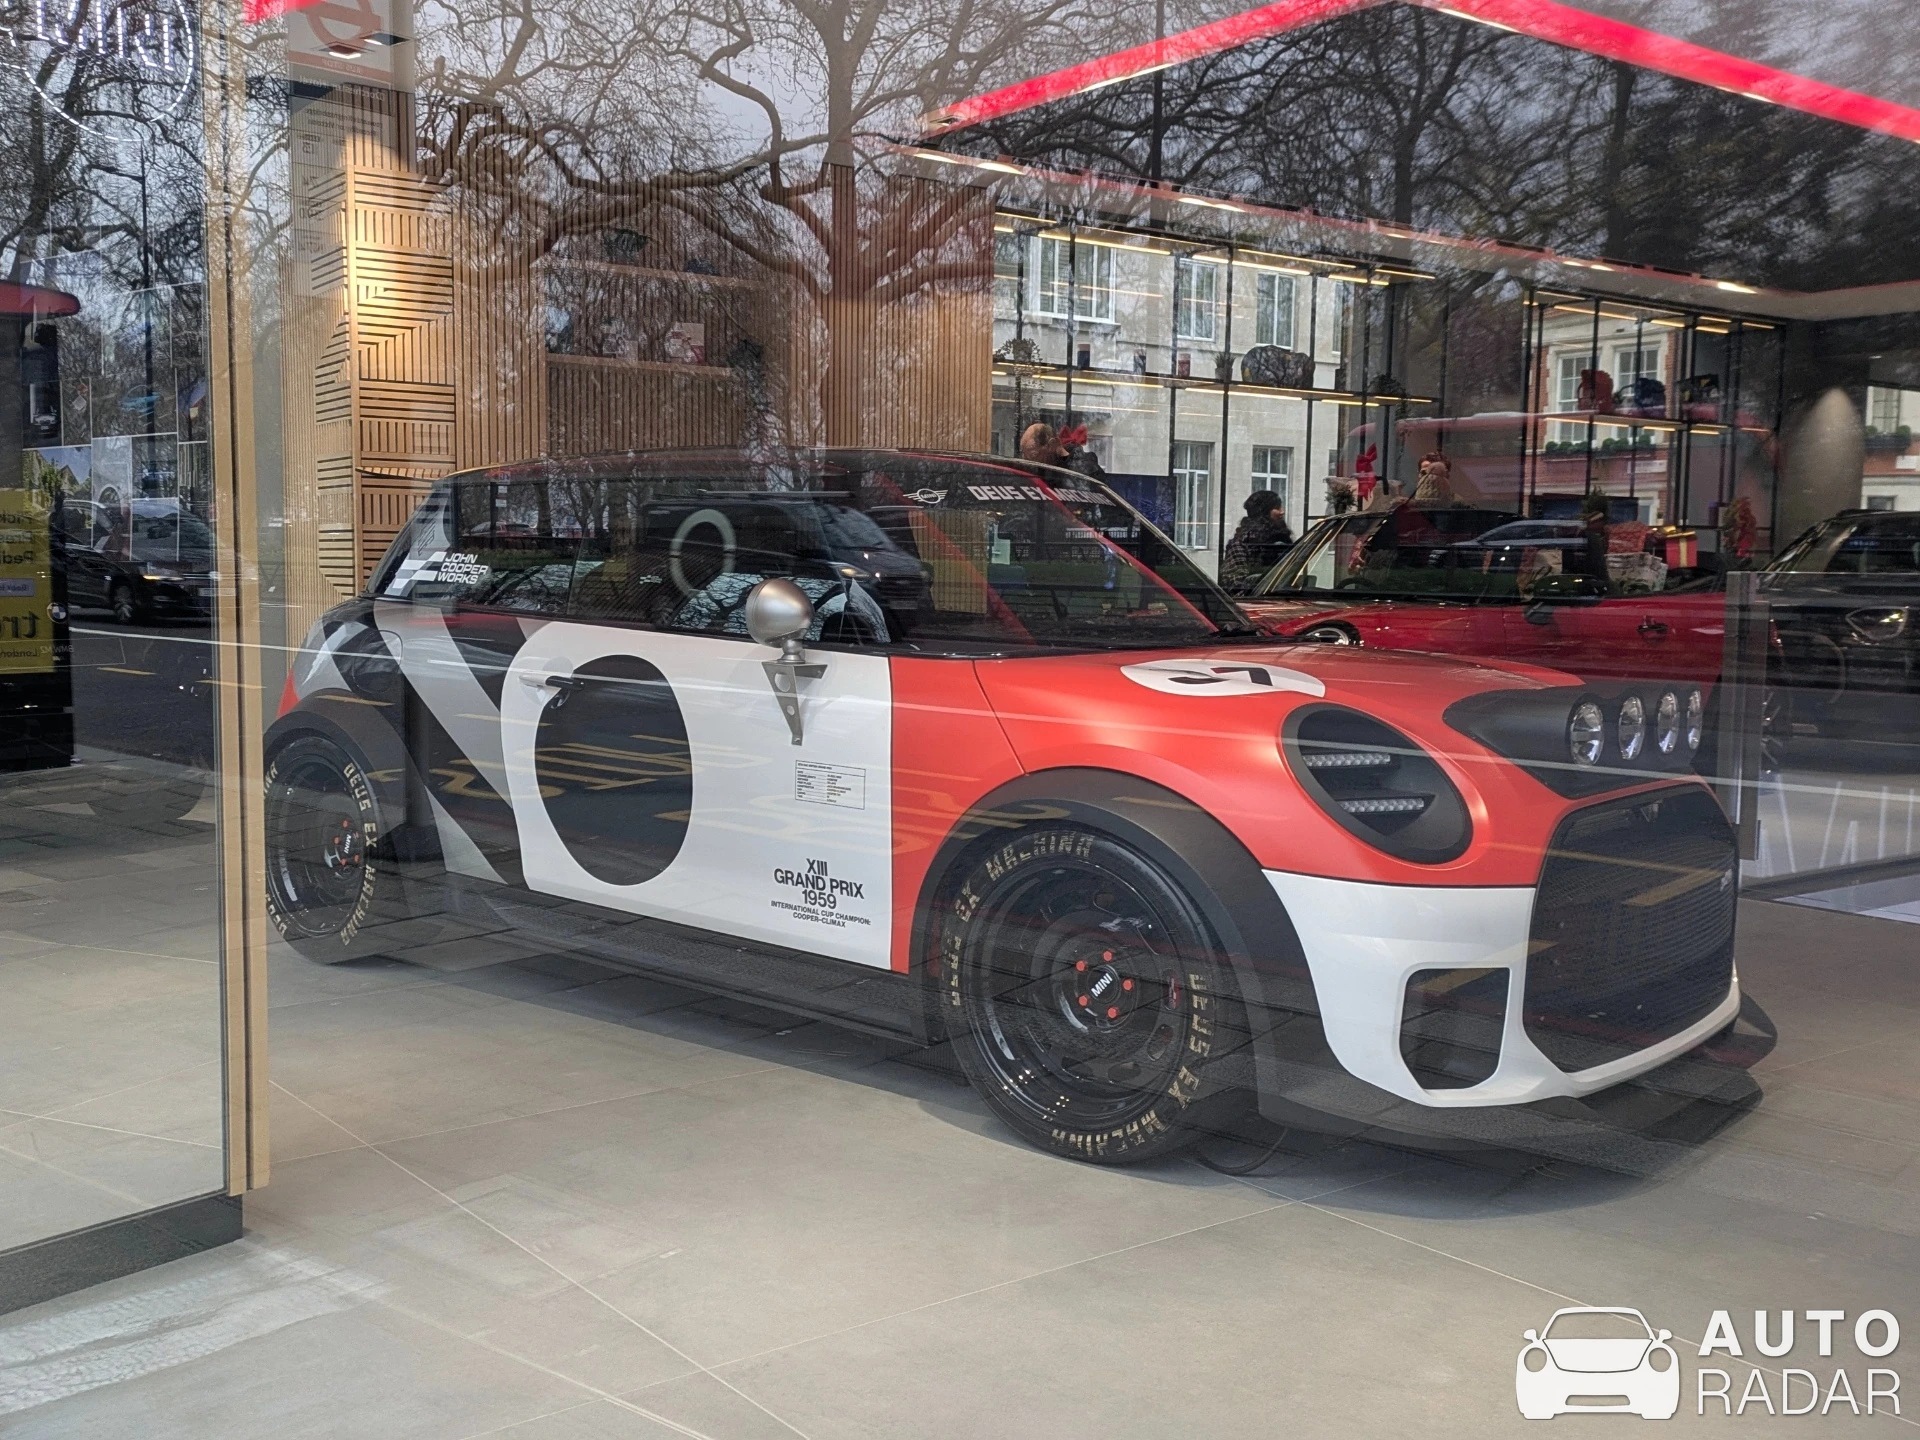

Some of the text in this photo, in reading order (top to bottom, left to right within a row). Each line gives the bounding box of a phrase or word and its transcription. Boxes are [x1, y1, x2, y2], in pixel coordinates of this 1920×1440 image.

[967, 485, 1117, 507] DEUS EX MACHINA
[445, 552, 478, 564] JOHN
[437, 571, 479, 585] WORKS
[440, 562, 489, 575] COOPER
[343, 833, 352, 854] MINI
[340, 762, 378, 946] DEUS EX MACHINA
[806, 858, 828, 877] XIII
[773, 868, 865, 900] GRAND PRIX
[770, 900, 820, 916] INTERNATIONAL
[820, 909, 835, 918] CUP
[801, 889, 837, 910] 1959
[792, 911, 846, 928] COOPER-CLIMAX
[1091, 972, 1113, 997] MINI
